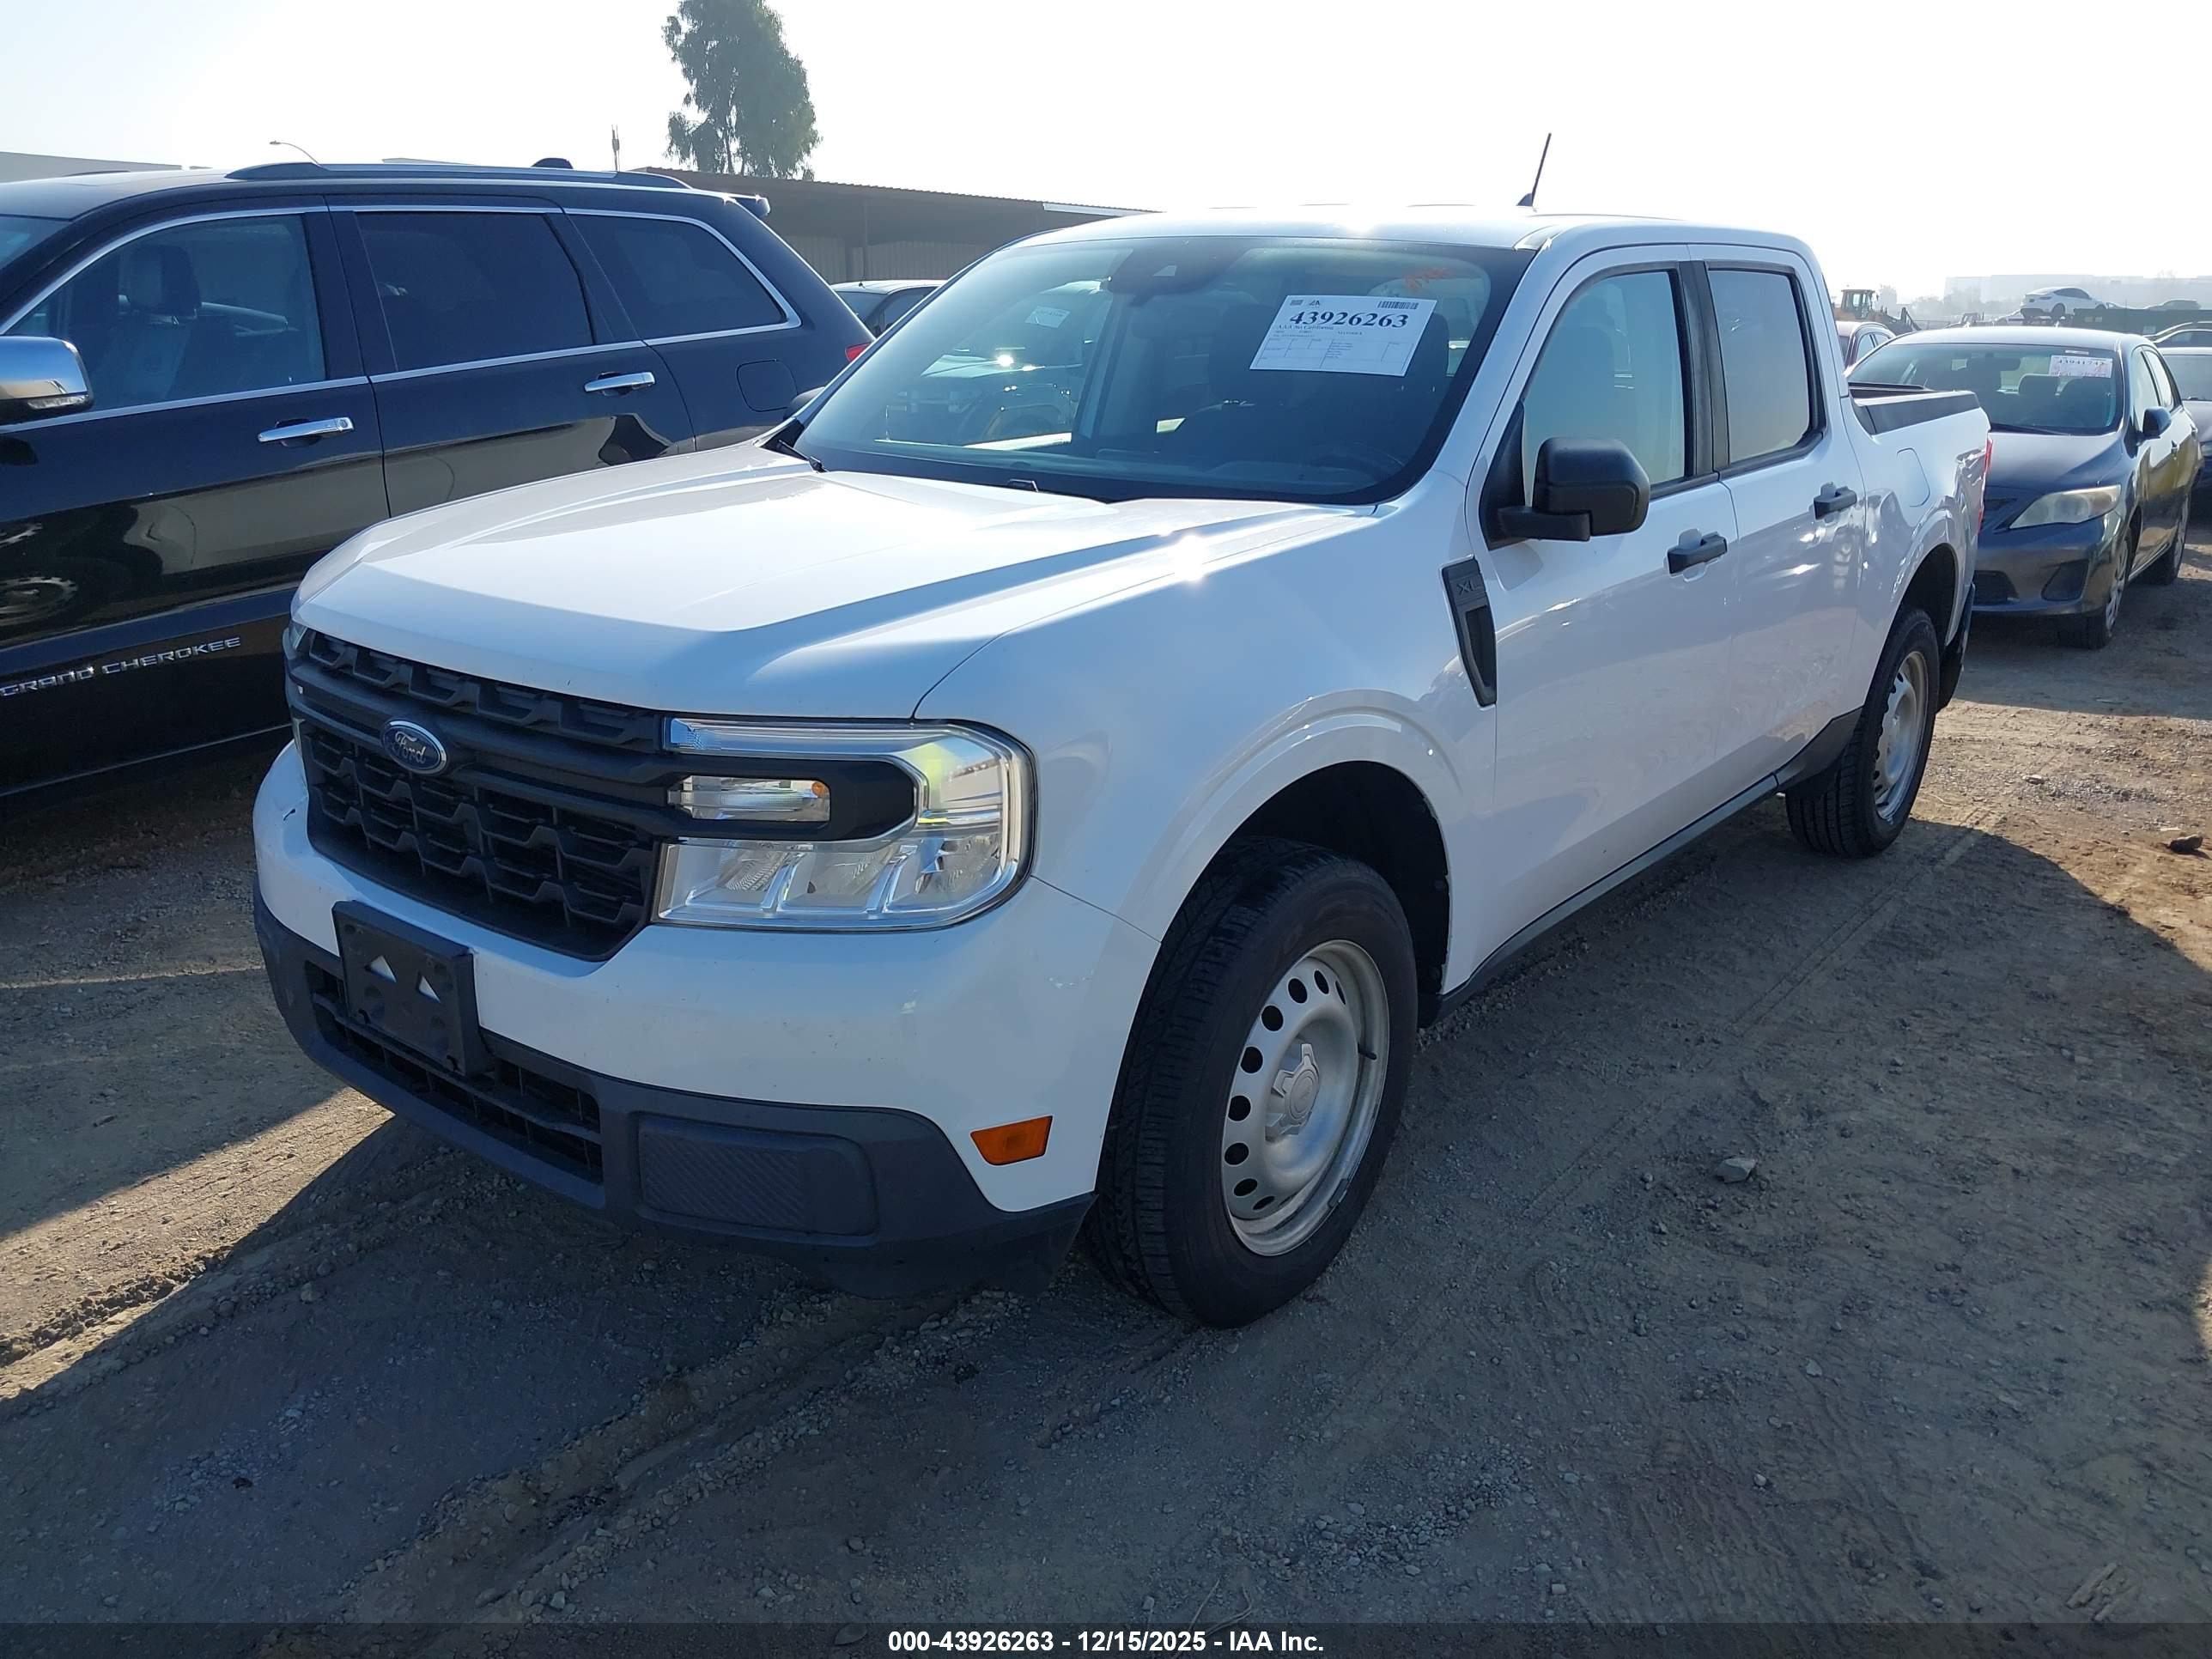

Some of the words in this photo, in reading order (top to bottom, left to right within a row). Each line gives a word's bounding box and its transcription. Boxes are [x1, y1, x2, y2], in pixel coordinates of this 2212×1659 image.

[1290, 311, 1409, 328] 43926263
[1455, 579, 1481, 596] XL
[0, 665, 94, 696] GRAND
[101, 637, 241, 674] CHEROKEE
[394, 731, 427, 764] Ford
